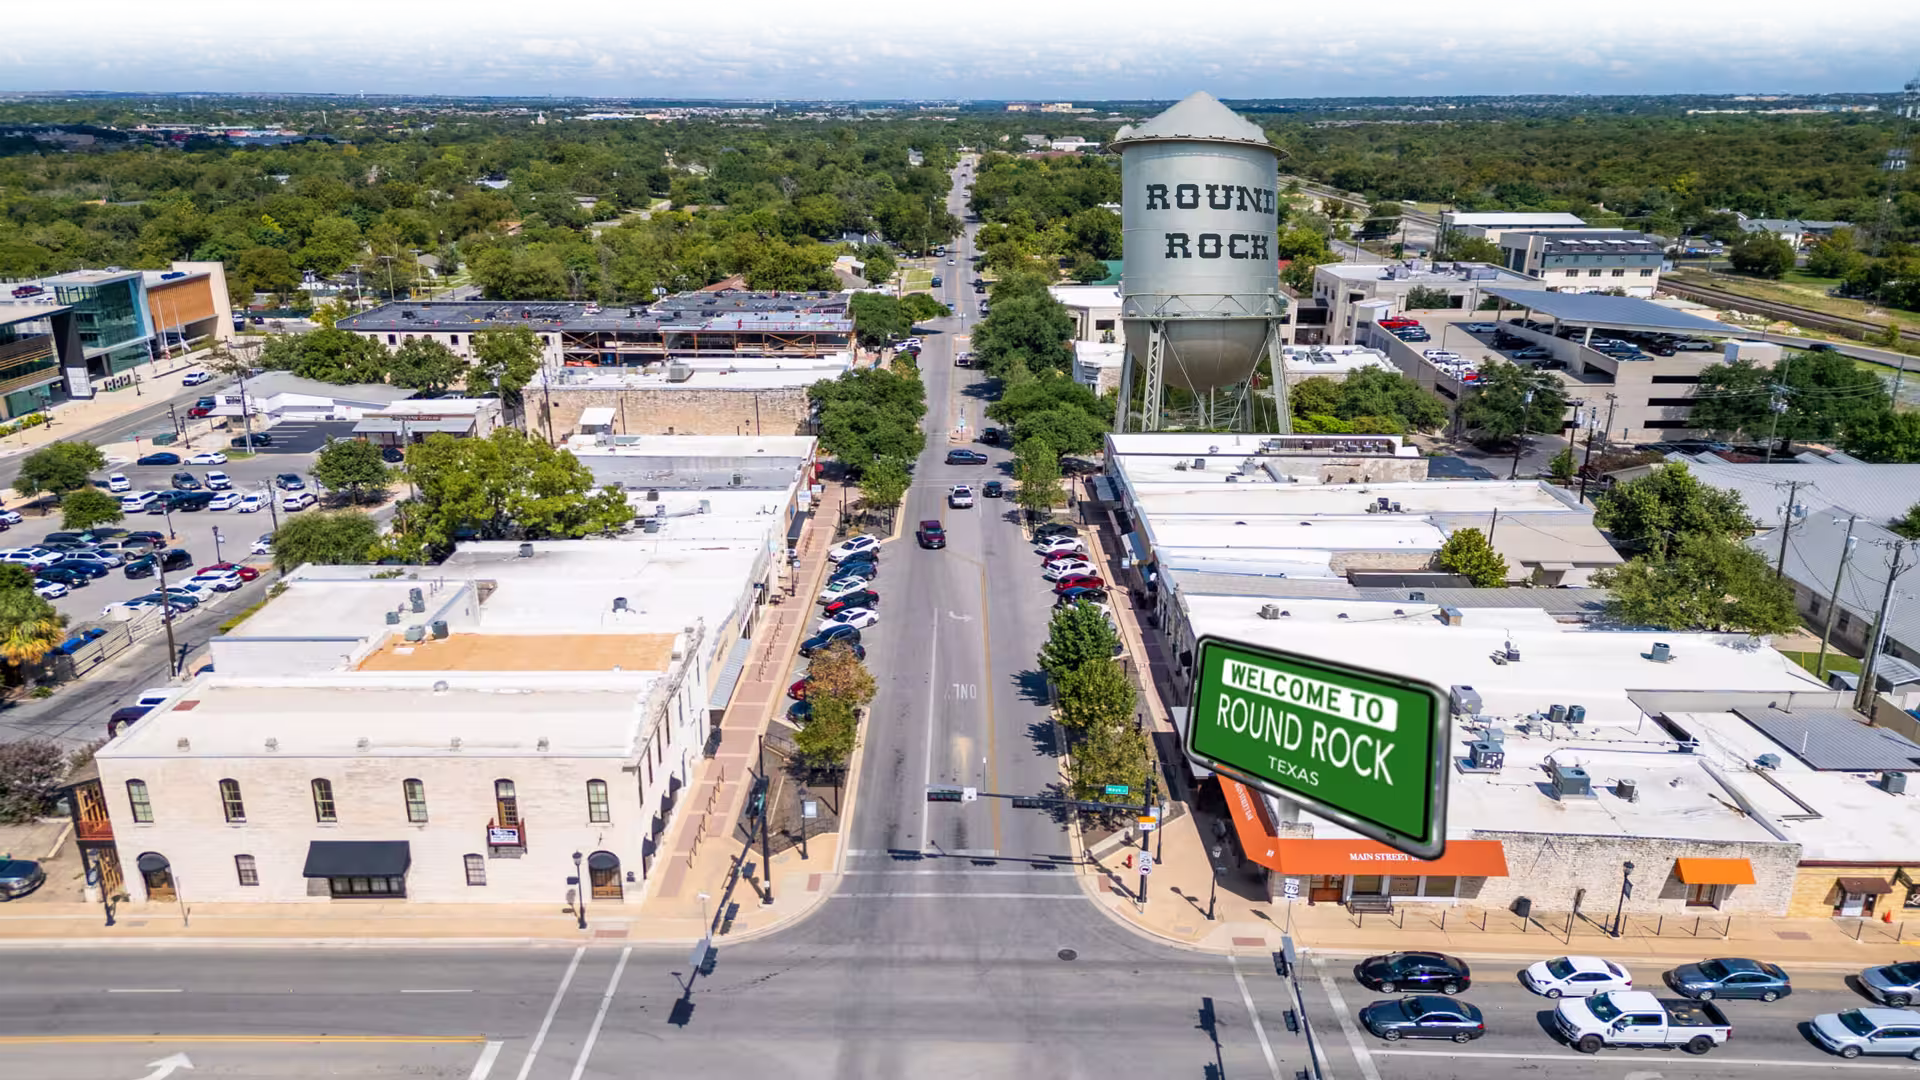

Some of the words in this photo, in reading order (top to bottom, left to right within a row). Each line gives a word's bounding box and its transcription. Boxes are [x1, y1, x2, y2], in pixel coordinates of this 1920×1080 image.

[1146, 183, 1276, 215] ROUND
[1165, 232, 1269, 260] ROCK
[1231, 662, 1342, 713] WELCOME
[1350, 692, 1384, 723] TO
[1216, 692, 1303, 751] ROUND
[1310, 720, 1395, 786] ROCK
[1268, 755, 1319, 786] TEXAS
[1349, 853, 1374, 861] MAIN
[1374, 853, 1409, 861] STREET
